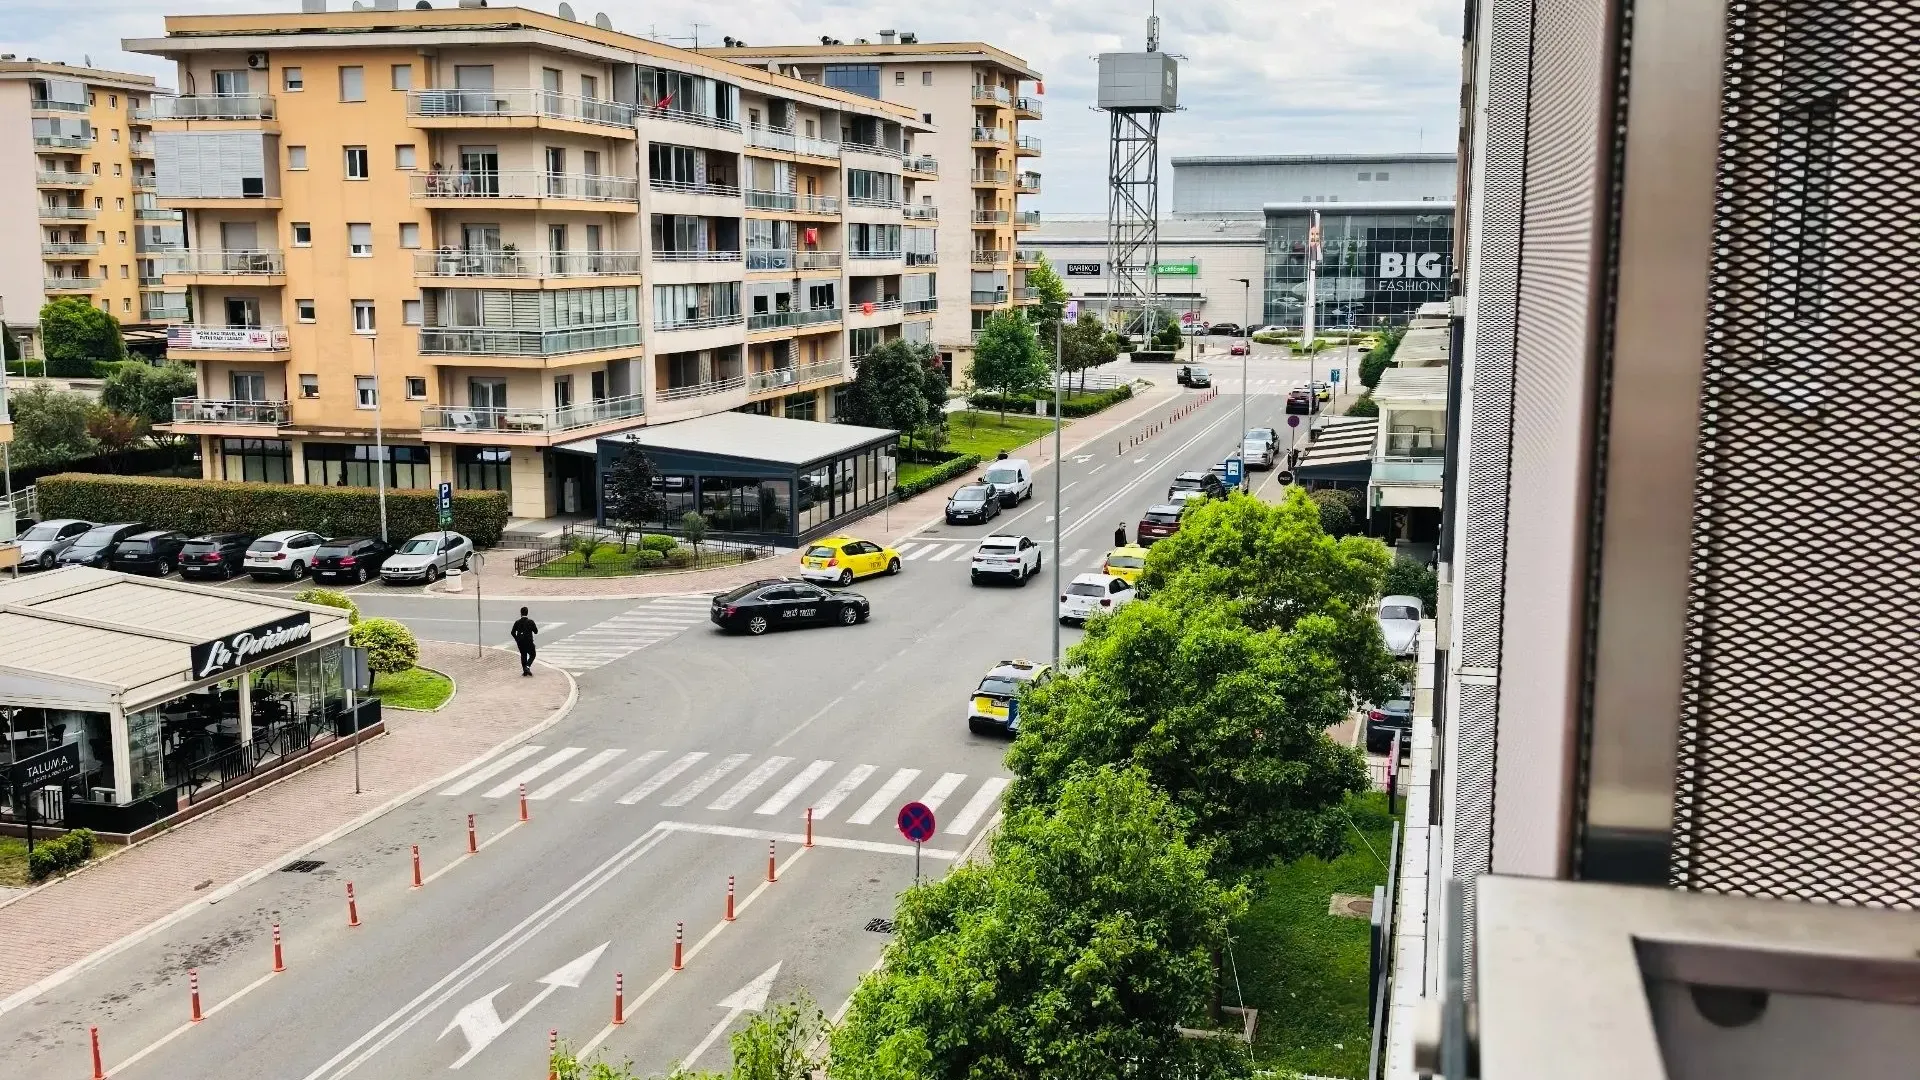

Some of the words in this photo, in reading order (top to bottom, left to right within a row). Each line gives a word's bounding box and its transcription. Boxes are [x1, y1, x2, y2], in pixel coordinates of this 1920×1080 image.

[1380, 252, 1442, 279] BIG
[1379, 280, 1441, 291] FASHION
[441, 484, 449, 498] P
[200, 640, 232, 677] La
[27, 756, 68, 777] TALUMA
